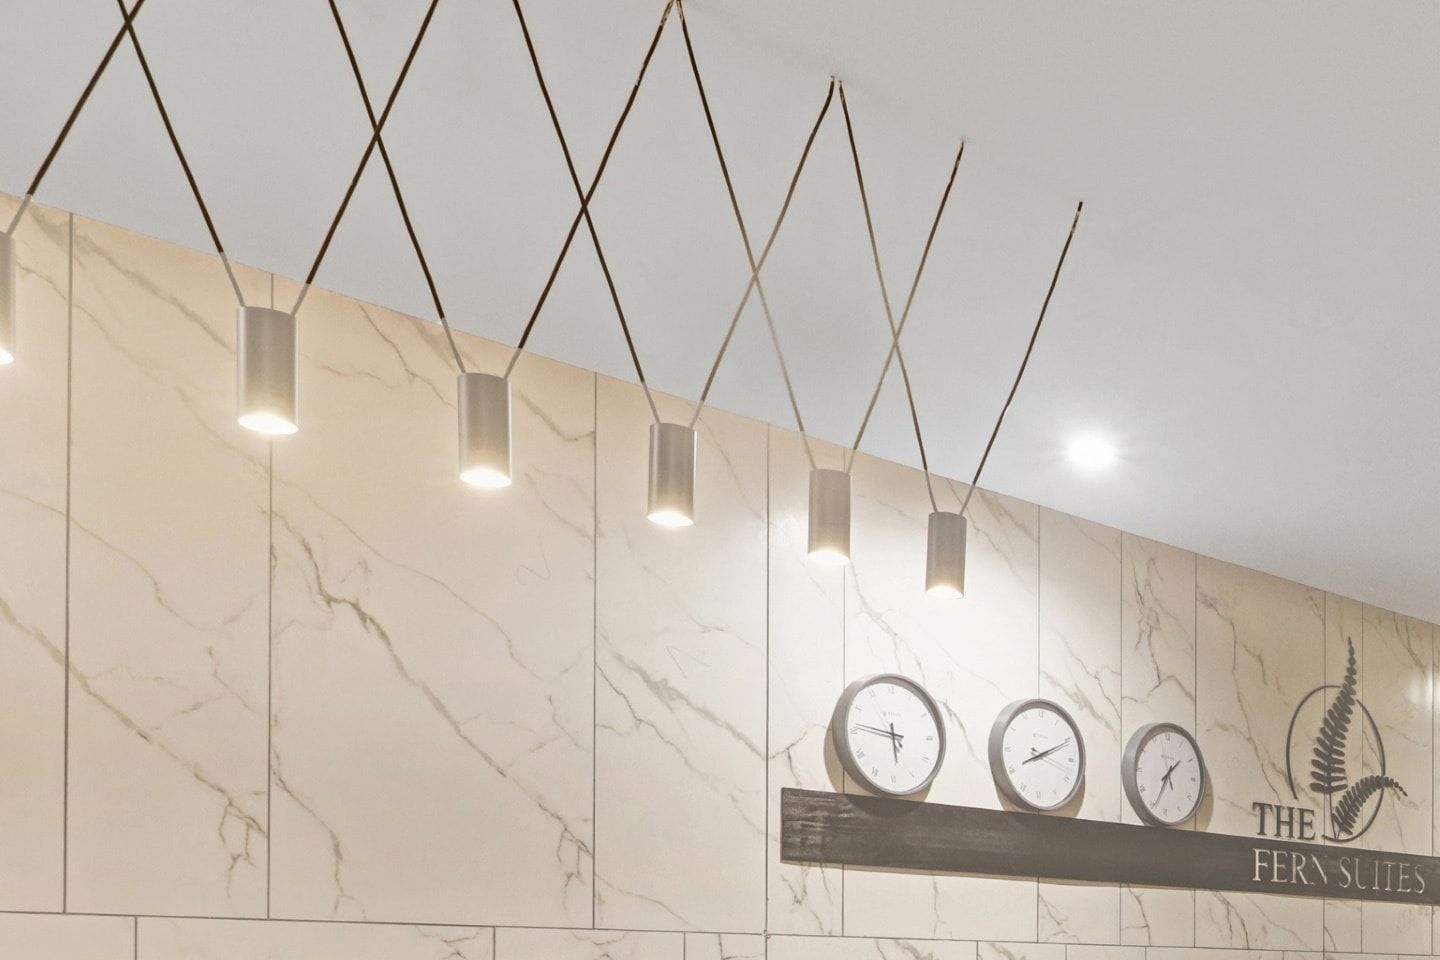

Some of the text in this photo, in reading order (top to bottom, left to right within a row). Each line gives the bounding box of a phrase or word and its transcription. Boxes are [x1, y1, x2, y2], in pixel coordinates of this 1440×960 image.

[1252, 801, 1317, 841] THE
[1252, 847, 1426, 894] FERN SUITES
